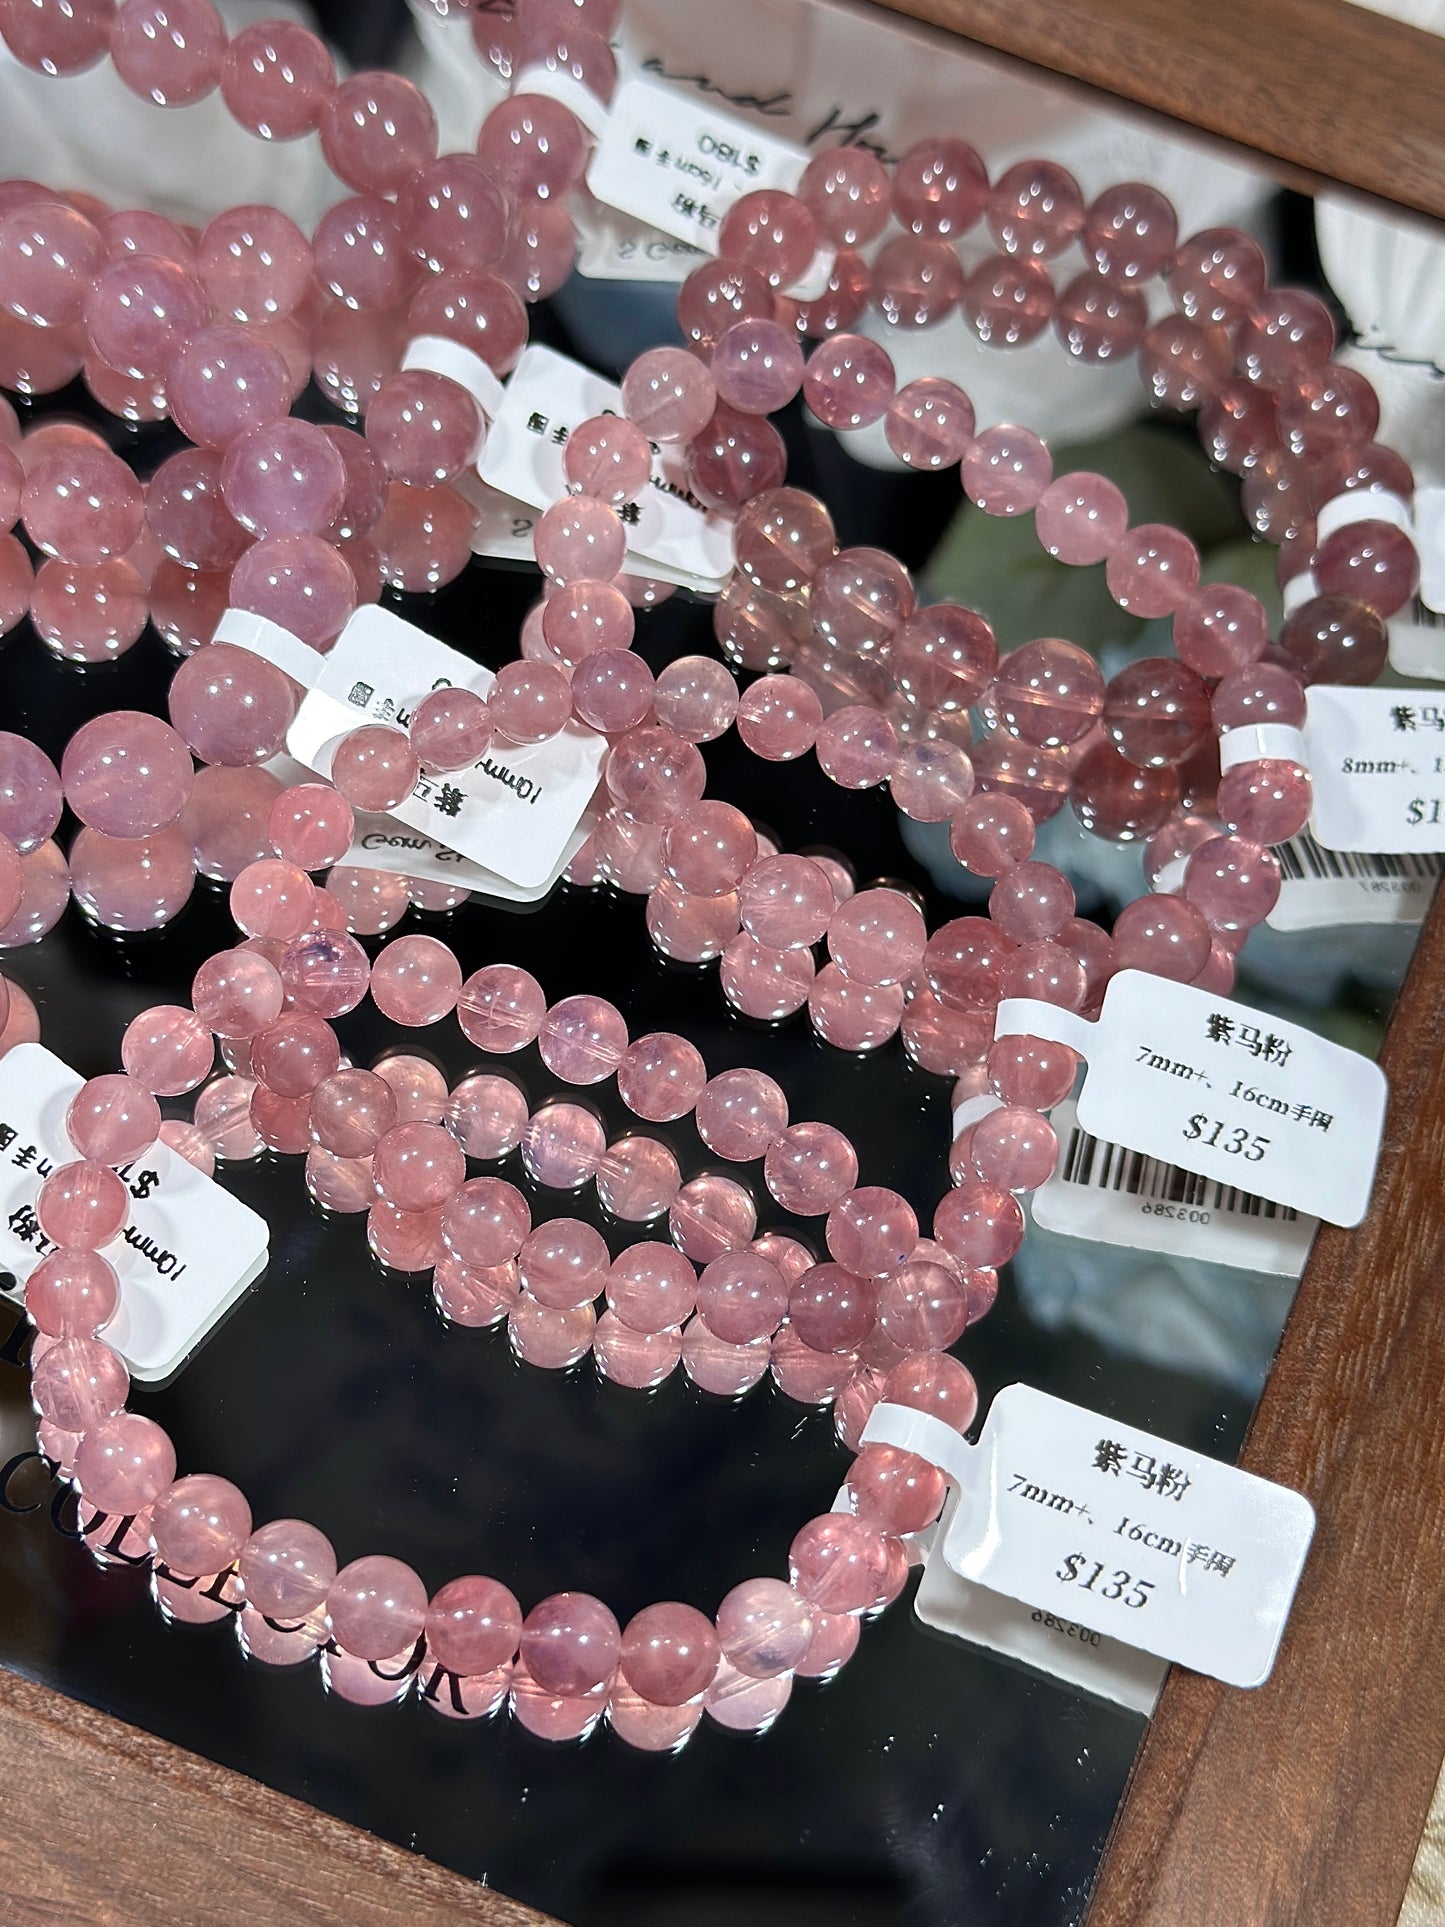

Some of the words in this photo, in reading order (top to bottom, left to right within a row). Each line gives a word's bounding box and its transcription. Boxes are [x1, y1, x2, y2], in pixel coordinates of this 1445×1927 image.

[1389, 705, 1445, 732] 紫马
[1406, 796, 1445, 827] $1
[1205, 1012, 1293, 1068] 紫马粉
[1182, 1112, 1271, 1162] $135
[1091, 1438, 1192, 1502] 紫马粉
[1055, 1552, 1155, 1610] $135
